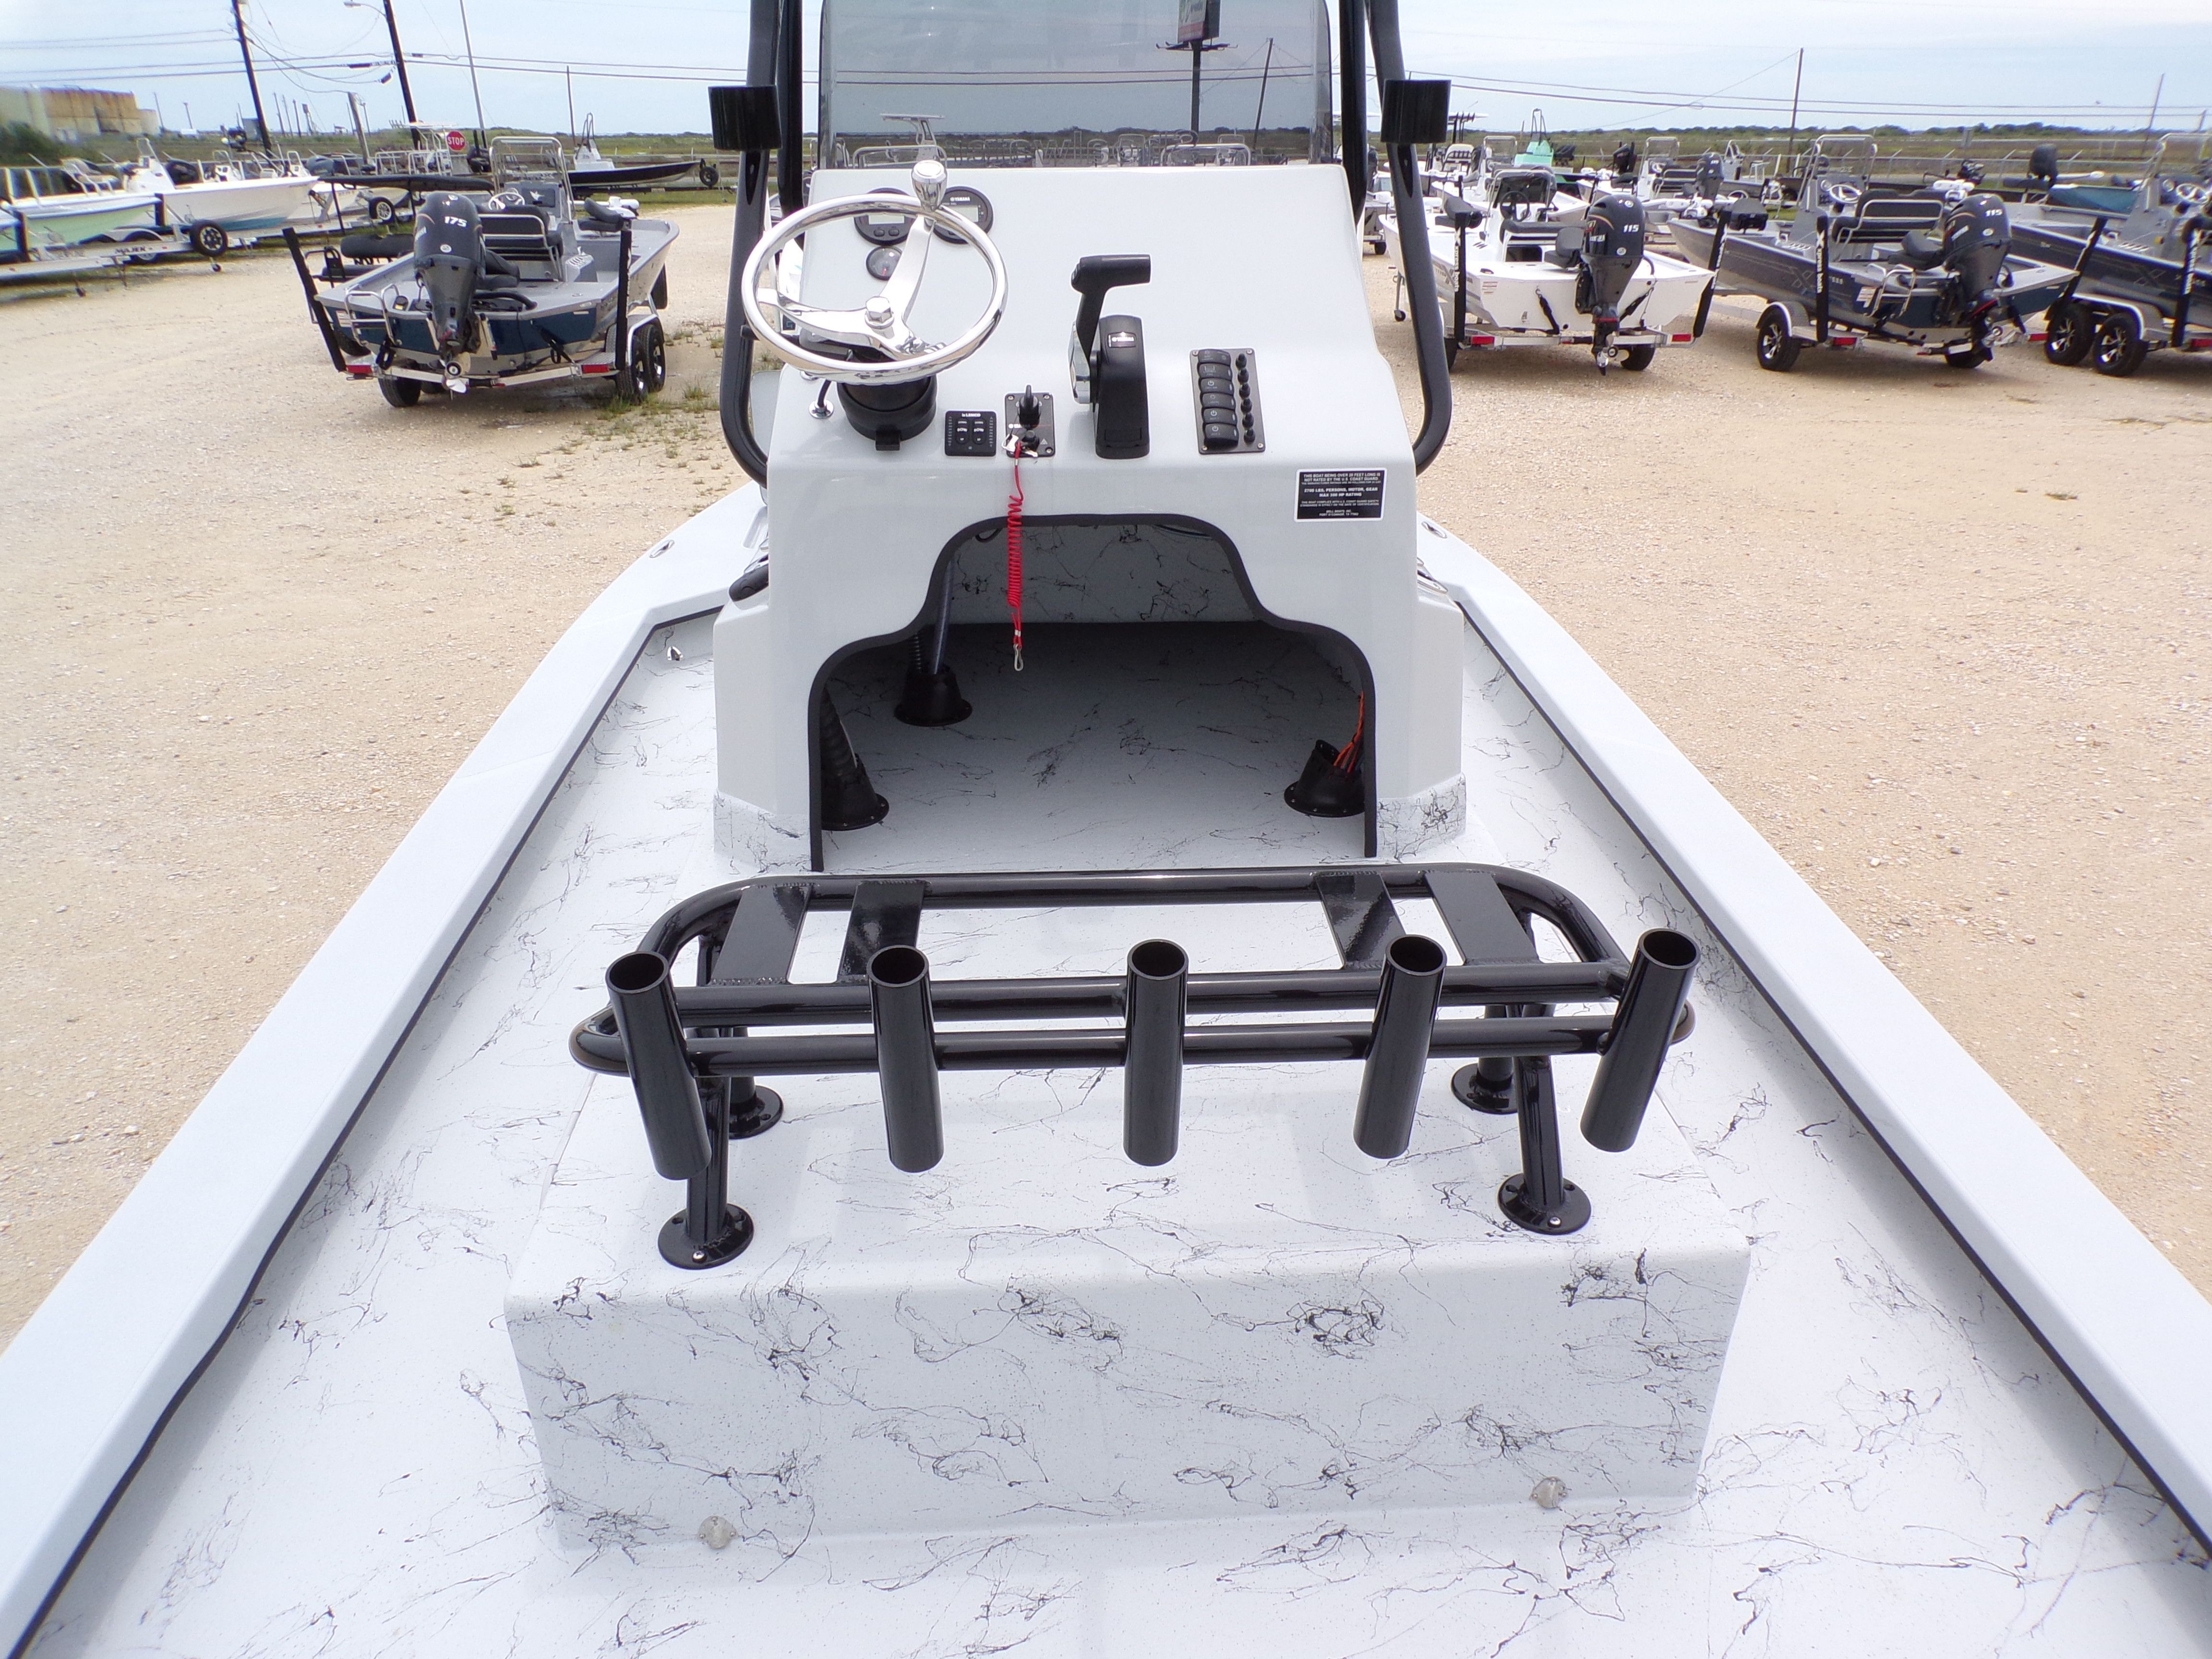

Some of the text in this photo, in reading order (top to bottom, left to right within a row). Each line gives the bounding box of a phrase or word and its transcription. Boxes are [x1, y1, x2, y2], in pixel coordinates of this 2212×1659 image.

[447, 136, 464, 146] STOP
[445, 216, 468, 227] 175
[1623, 225, 1639, 233] 115
